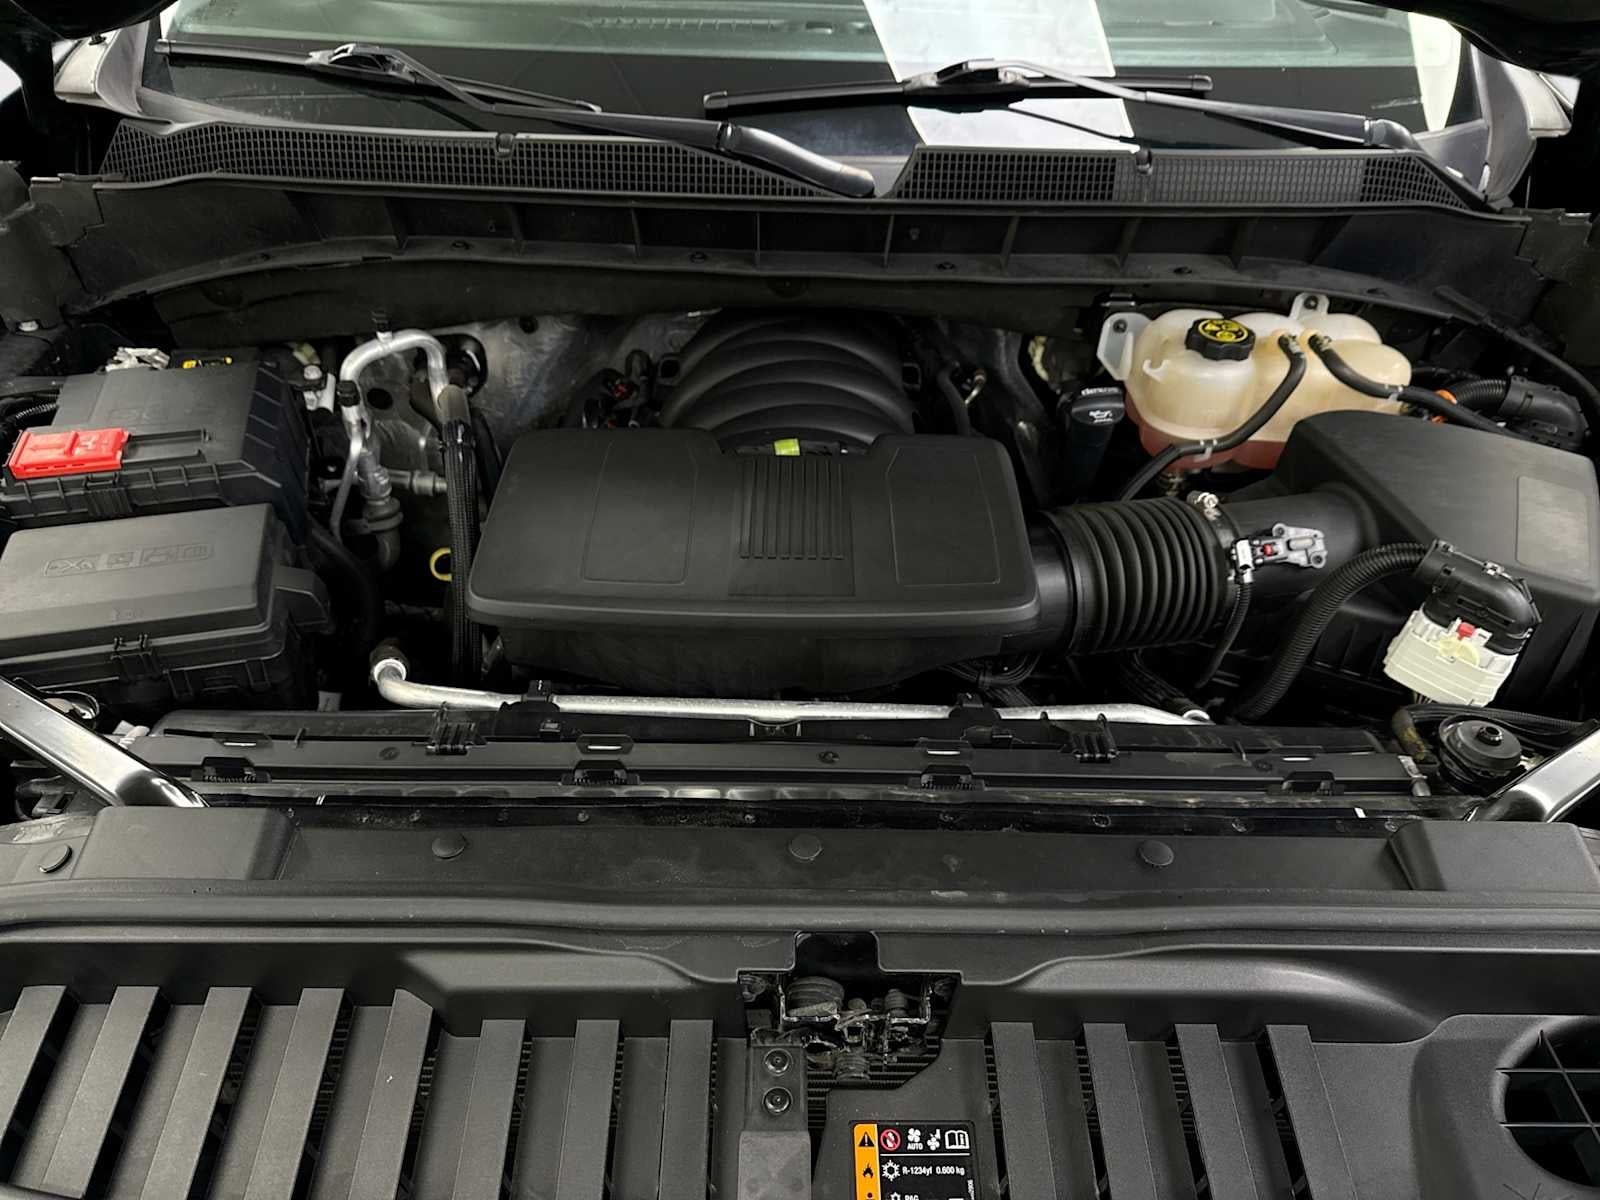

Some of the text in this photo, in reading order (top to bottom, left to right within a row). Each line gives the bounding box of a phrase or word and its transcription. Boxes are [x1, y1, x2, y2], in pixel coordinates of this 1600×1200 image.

[902, 1166, 965, 1176] R-1234yf 0.600 kg
